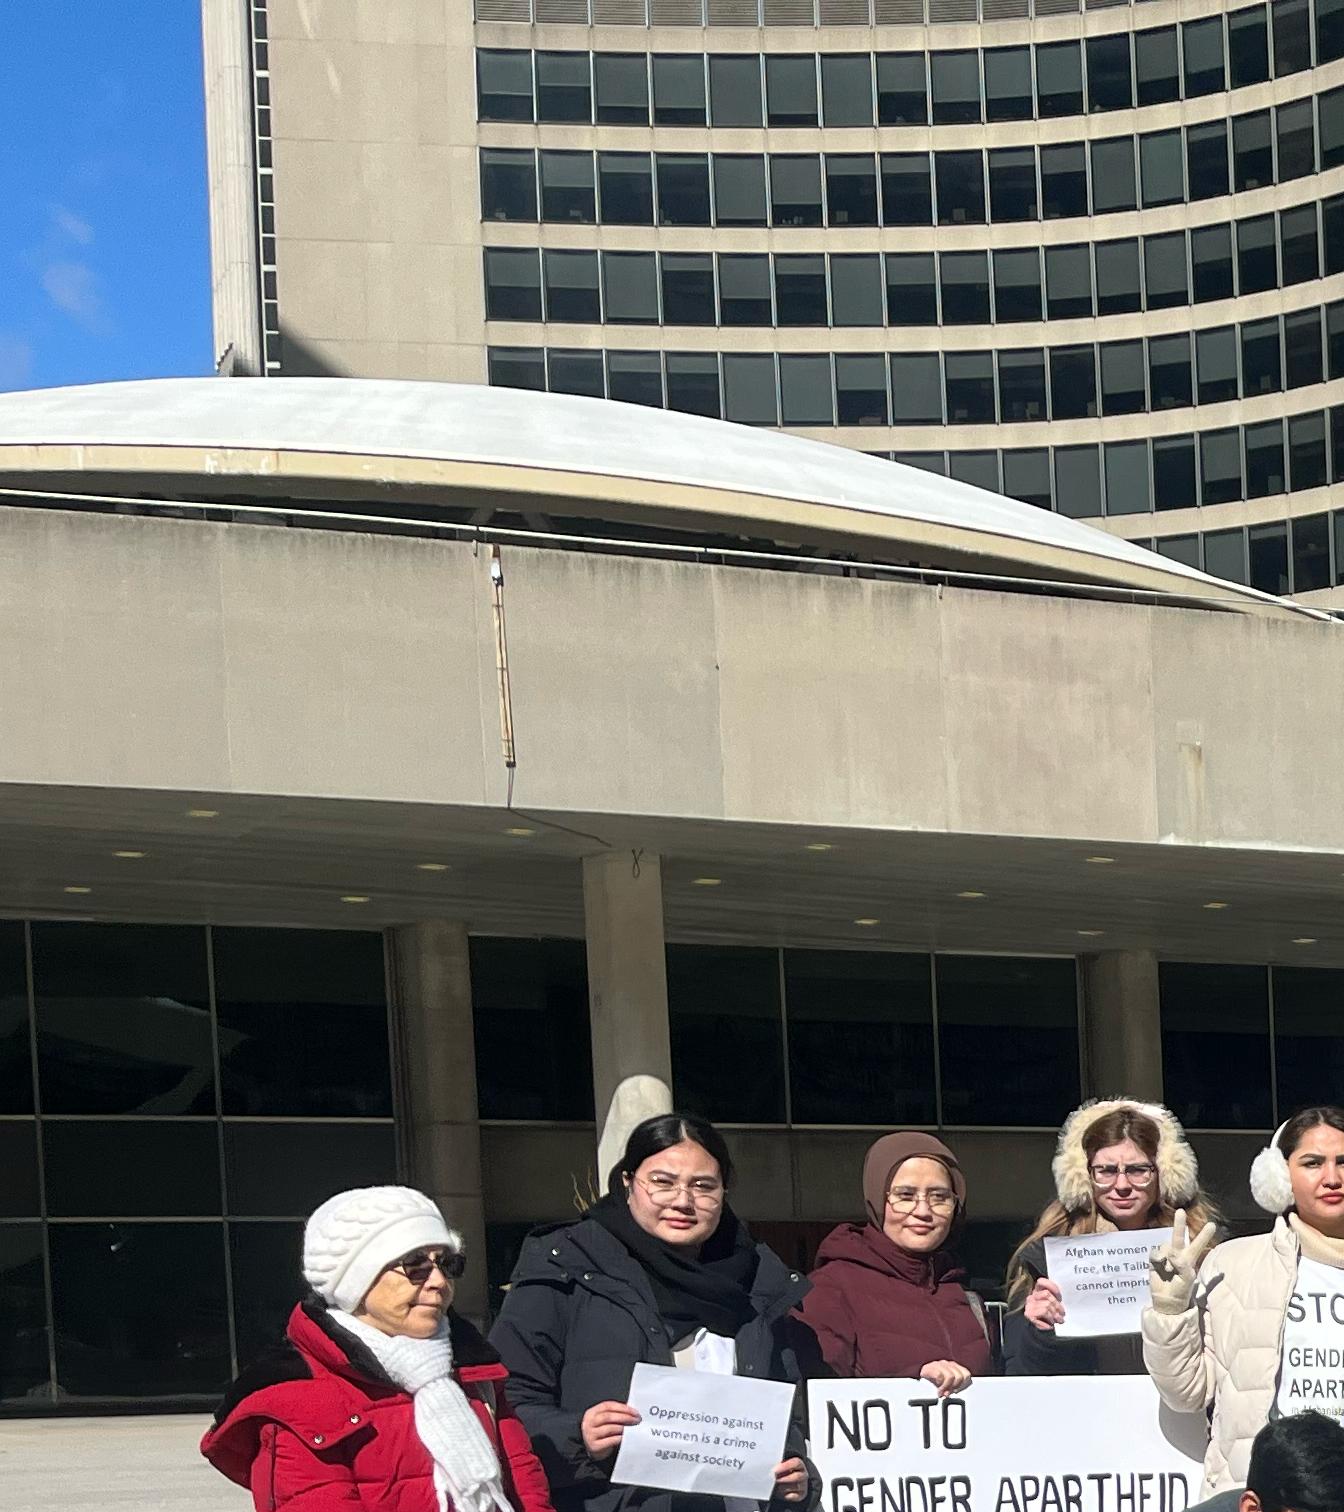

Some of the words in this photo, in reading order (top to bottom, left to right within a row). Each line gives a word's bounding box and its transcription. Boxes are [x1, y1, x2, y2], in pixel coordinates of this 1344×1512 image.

[1065, 1247, 1104, 1259] Afghan
[1107, 1245, 1147, 1256] women
[1074, 1264, 1099, 1275] free,
[1102, 1263, 1120, 1273] the
[1123, 1261, 1151, 1272] Talib
[1076, 1281, 1114, 1292] cannot
[1117, 1279, 1150, 1290] impris
[1108, 1296, 1137, 1305] them
[649, 1405, 719, 1425] Oppression
[723, 1415, 764, 1431] against
[826, 1398, 892, 1451] NO
[907, 1397, 967, 1450] TO
[651, 1427, 698, 1443] women
[701, 1433, 711, 1443] is
[713, 1437, 720, 1445] a
[723, 1436, 757, 1450] crime
[655, 1448, 701, 1464] against
[703, 1454, 745, 1471] society
